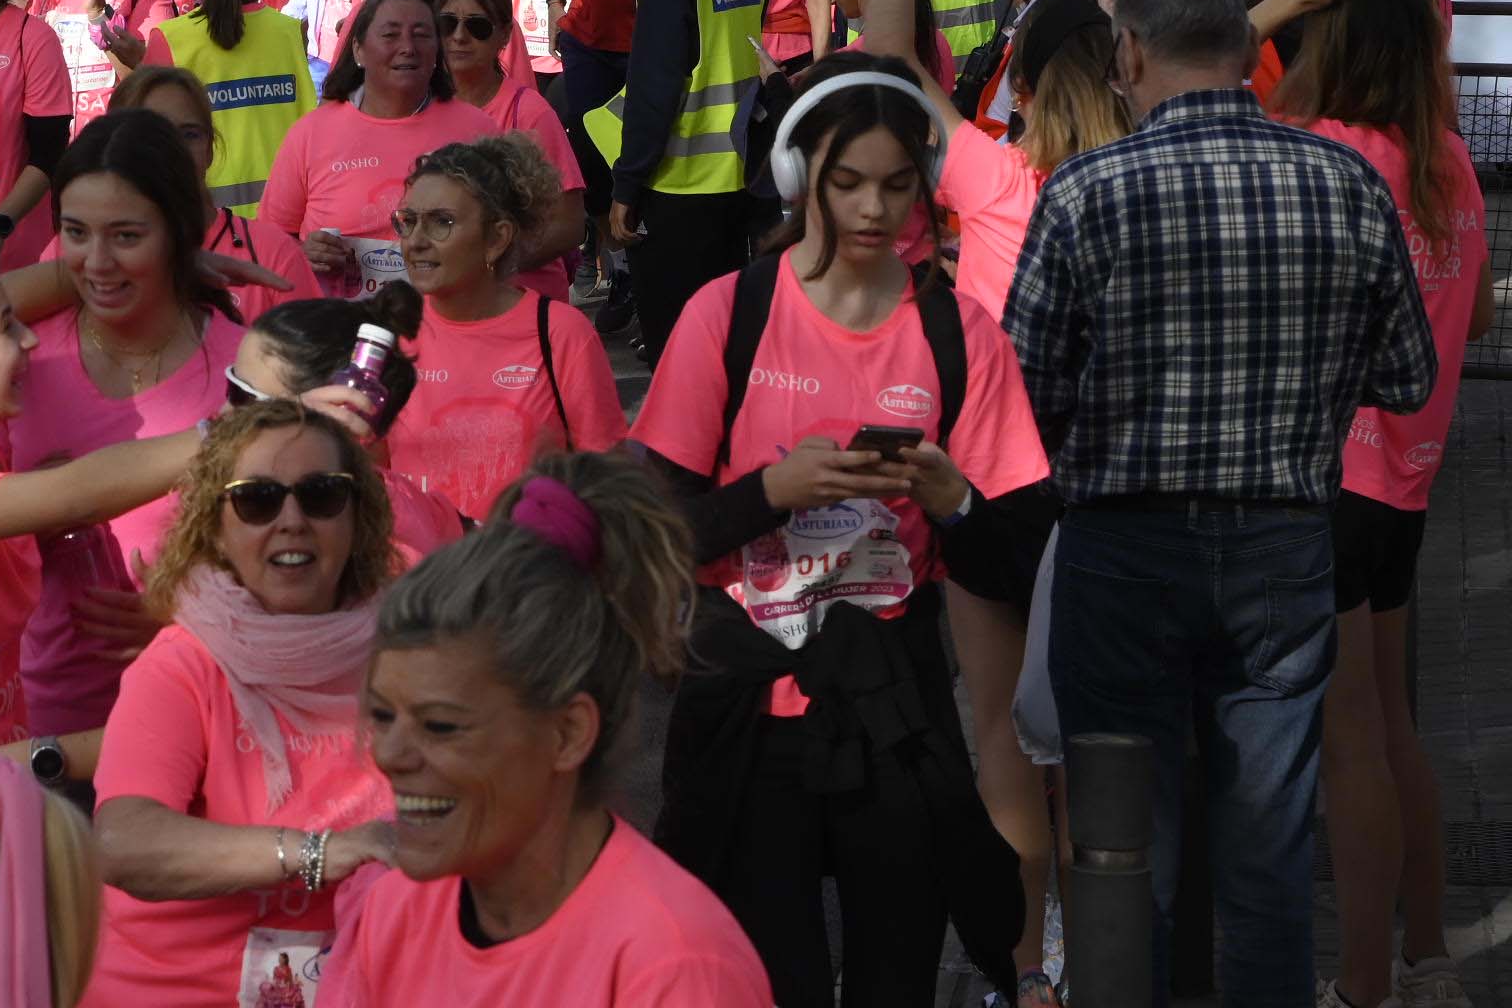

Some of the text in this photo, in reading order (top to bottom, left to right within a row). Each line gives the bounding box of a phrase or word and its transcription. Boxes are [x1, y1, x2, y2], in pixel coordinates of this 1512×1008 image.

[208, 81, 294, 105] VOLUNTARIS
[331, 156, 380, 173] OYSHO
[418, 369, 448, 383] SHO
[749, 368, 821, 394] OYSHO
[792, 518, 858, 531] ASTURIANA
[796, 551, 852, 576] 016
